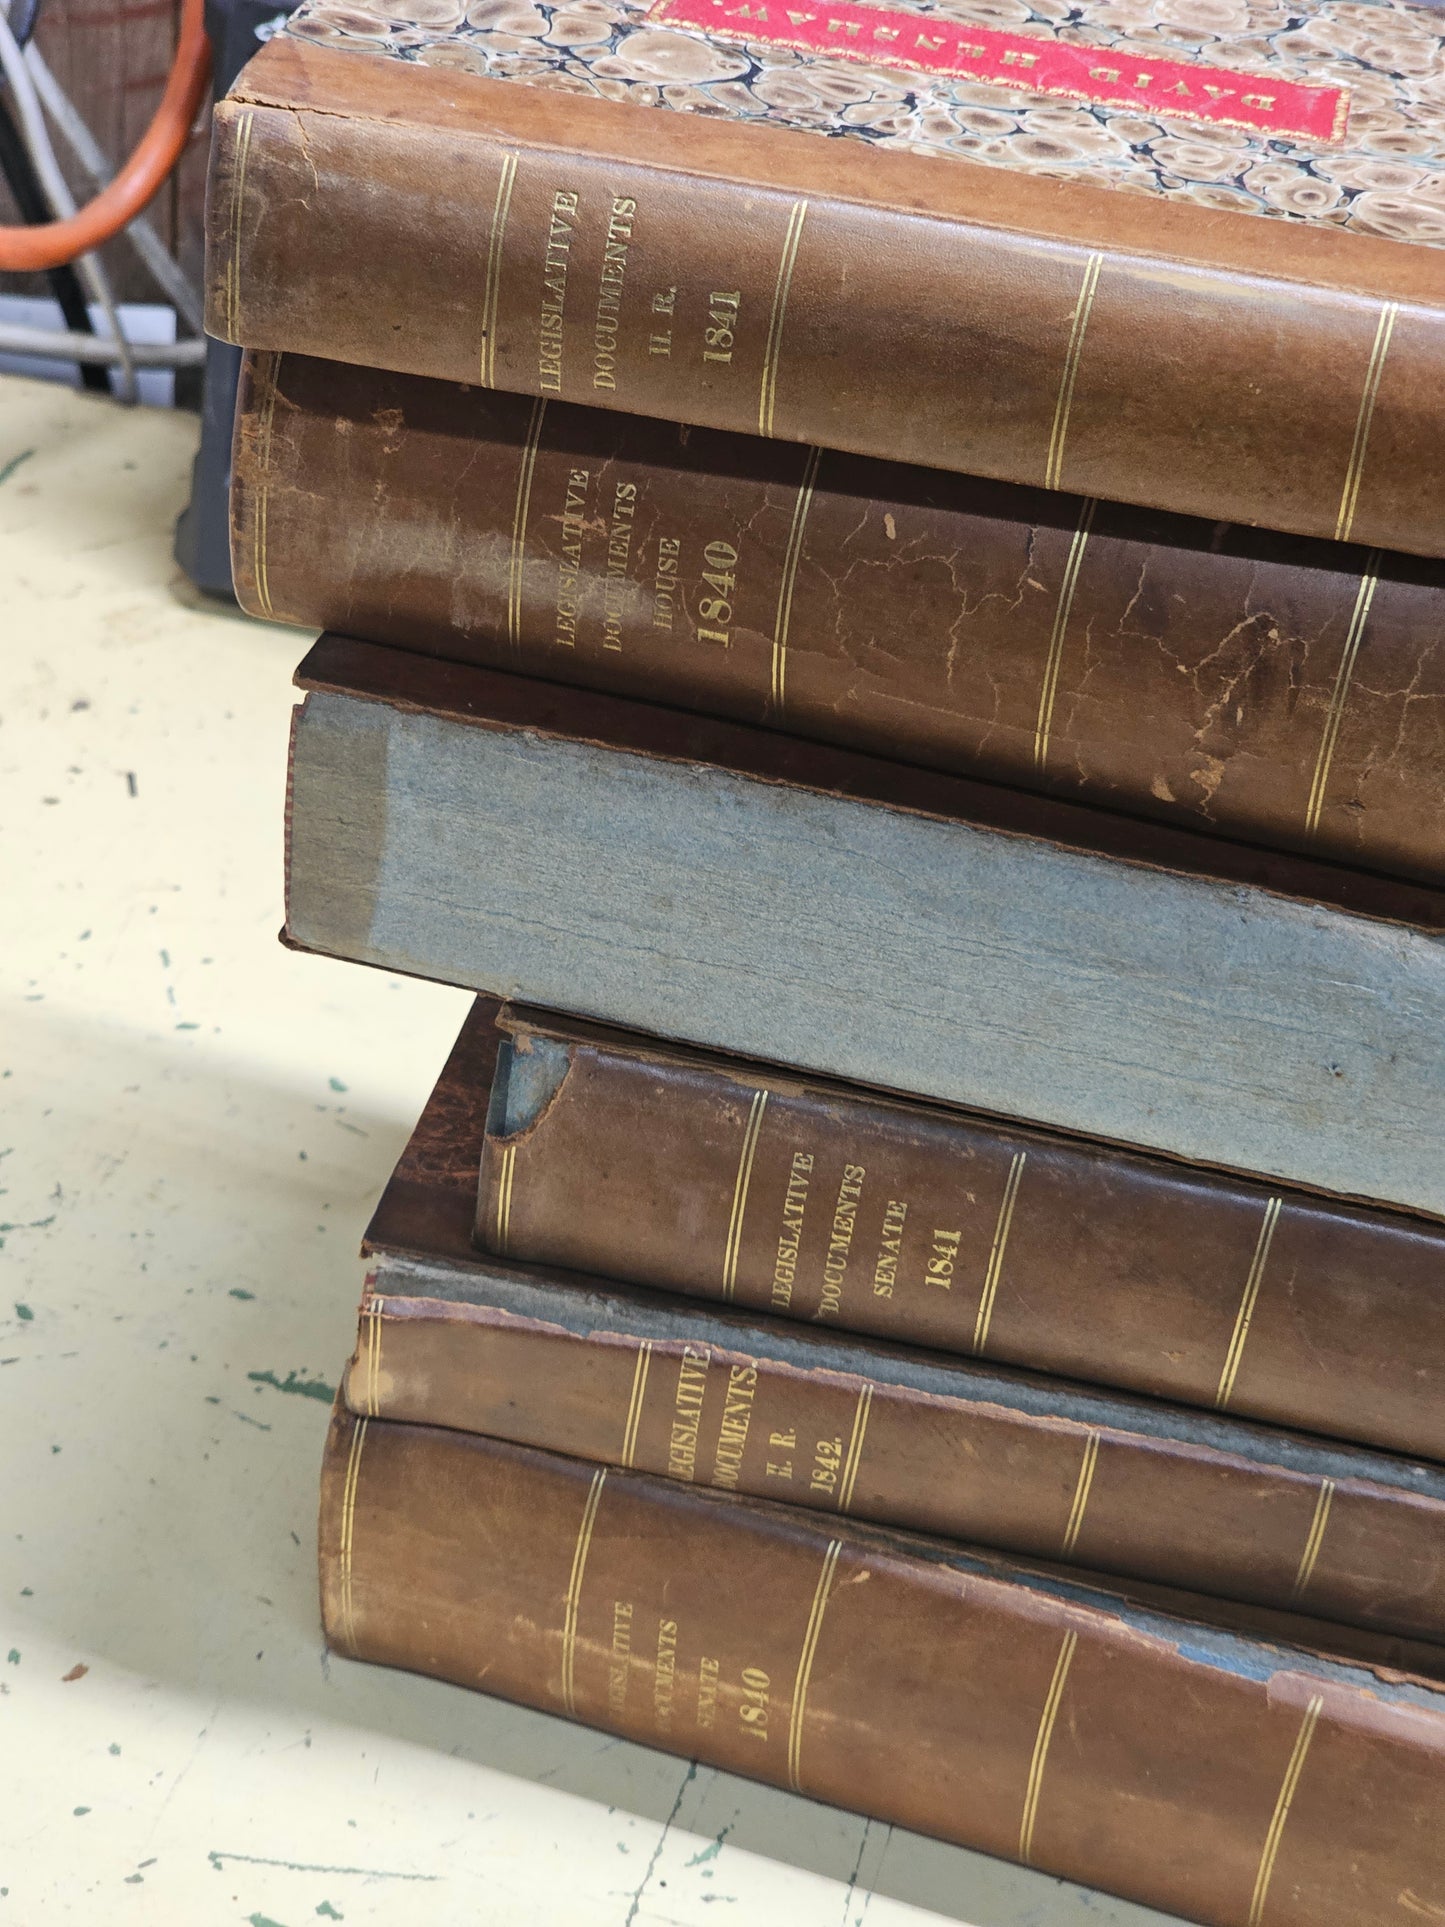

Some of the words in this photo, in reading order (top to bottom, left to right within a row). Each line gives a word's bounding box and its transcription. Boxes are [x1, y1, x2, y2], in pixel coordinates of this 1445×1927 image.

[1089, 66, 1276, 111] DAVID
[539, 190, 578, 392] LEGISLATIVE
[593, 195, 637, 391] DOCUMENTS
[652, 285, 677, 316] R.
[703, 290, 740, 366] 1841
[555, 469, 590, 650] LEGISLATIVE
[602, 480, 638, 653] DOCUMENTS
[653, 537, 681, 630] HOUSE
[697, 540, 739, 649] 1840
[771, 1152, 815, 1309] LEGISLATIVE
[817, 1164, 867, 1316] DOCUMENTS
[873, 1200, 908, 1300] SENATE
[924, 1228, 962, 1290] 1841
[668, 1346, 712, 1482] EGISLATIVE
[769, 1427, 797, 1450] R.
[809, 1436, 843, 1495] 1842.
[738, 1667, 771, 1743] 1840
